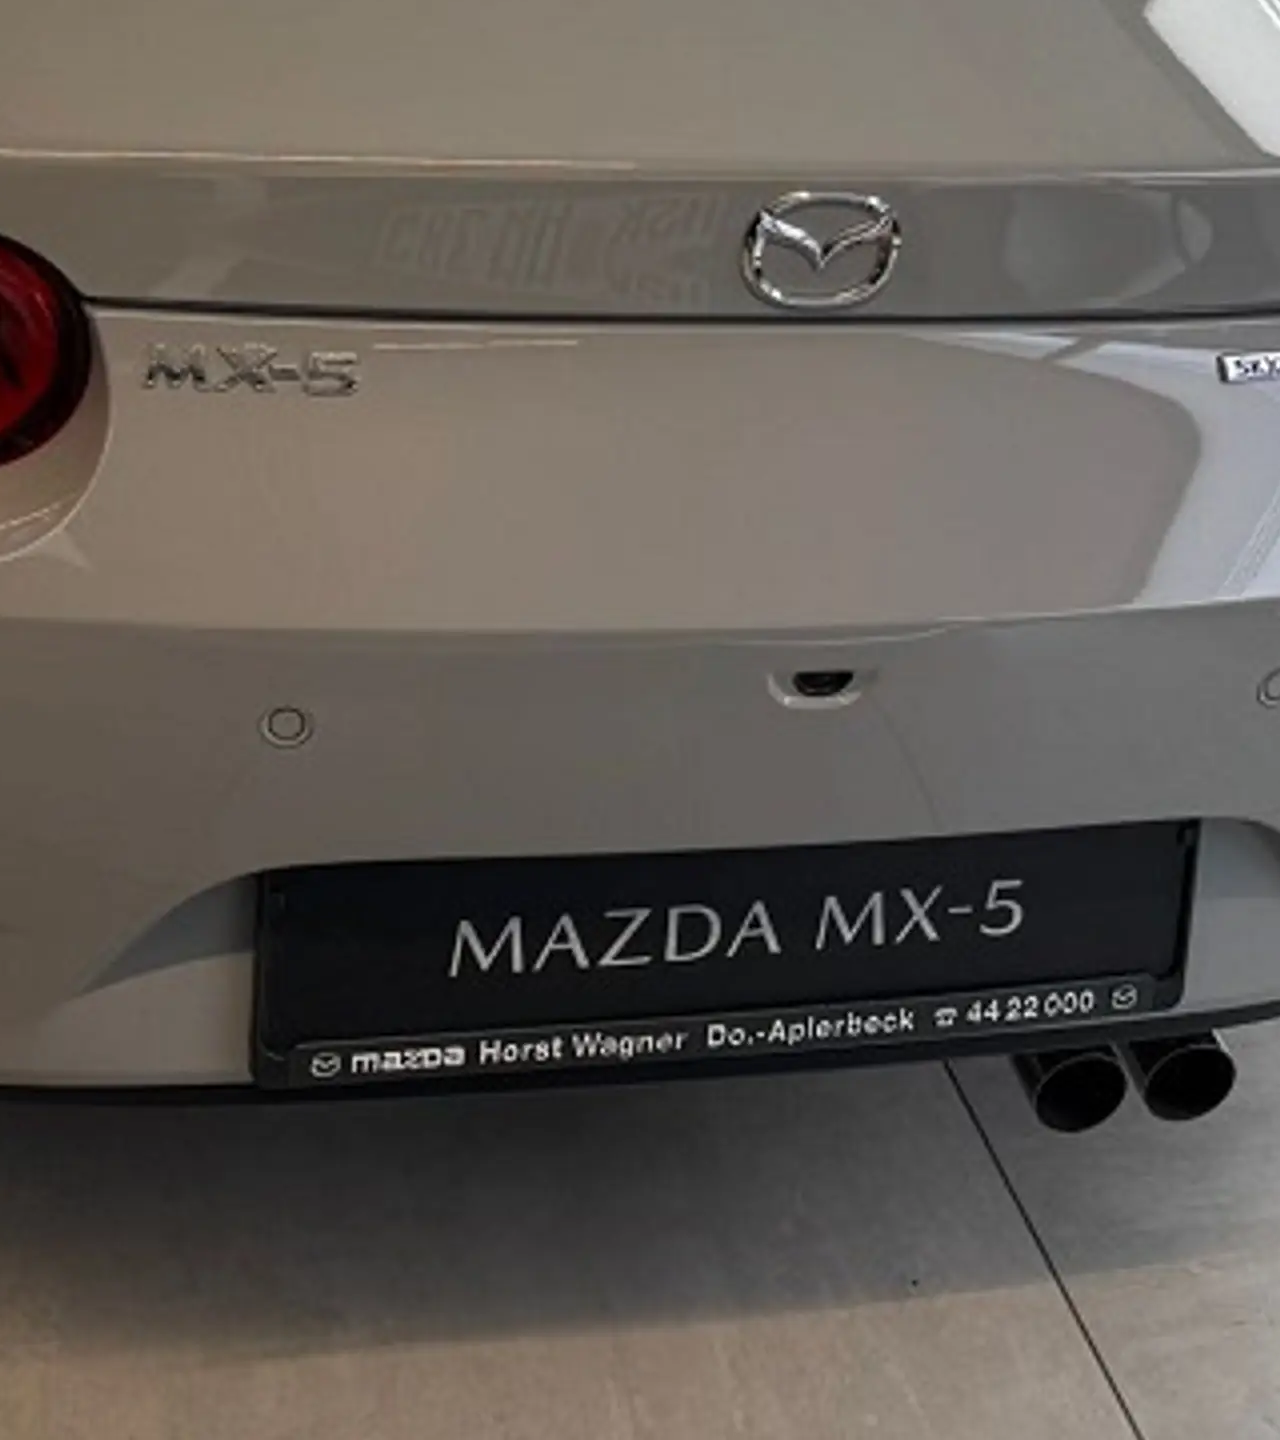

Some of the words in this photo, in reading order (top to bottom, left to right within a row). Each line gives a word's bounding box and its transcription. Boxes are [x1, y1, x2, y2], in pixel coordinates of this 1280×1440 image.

[142, 343, 361, 398] MX-5
[449, 901, 783, 979] MAZDA
[815, 879, 1025, 952] MX-5
[479, 1037, 564, 1066] Horst
[570, 1030, 690, 1062] Wagner
[706, 1006, 915, 1049] Do.-Aplerbeck
